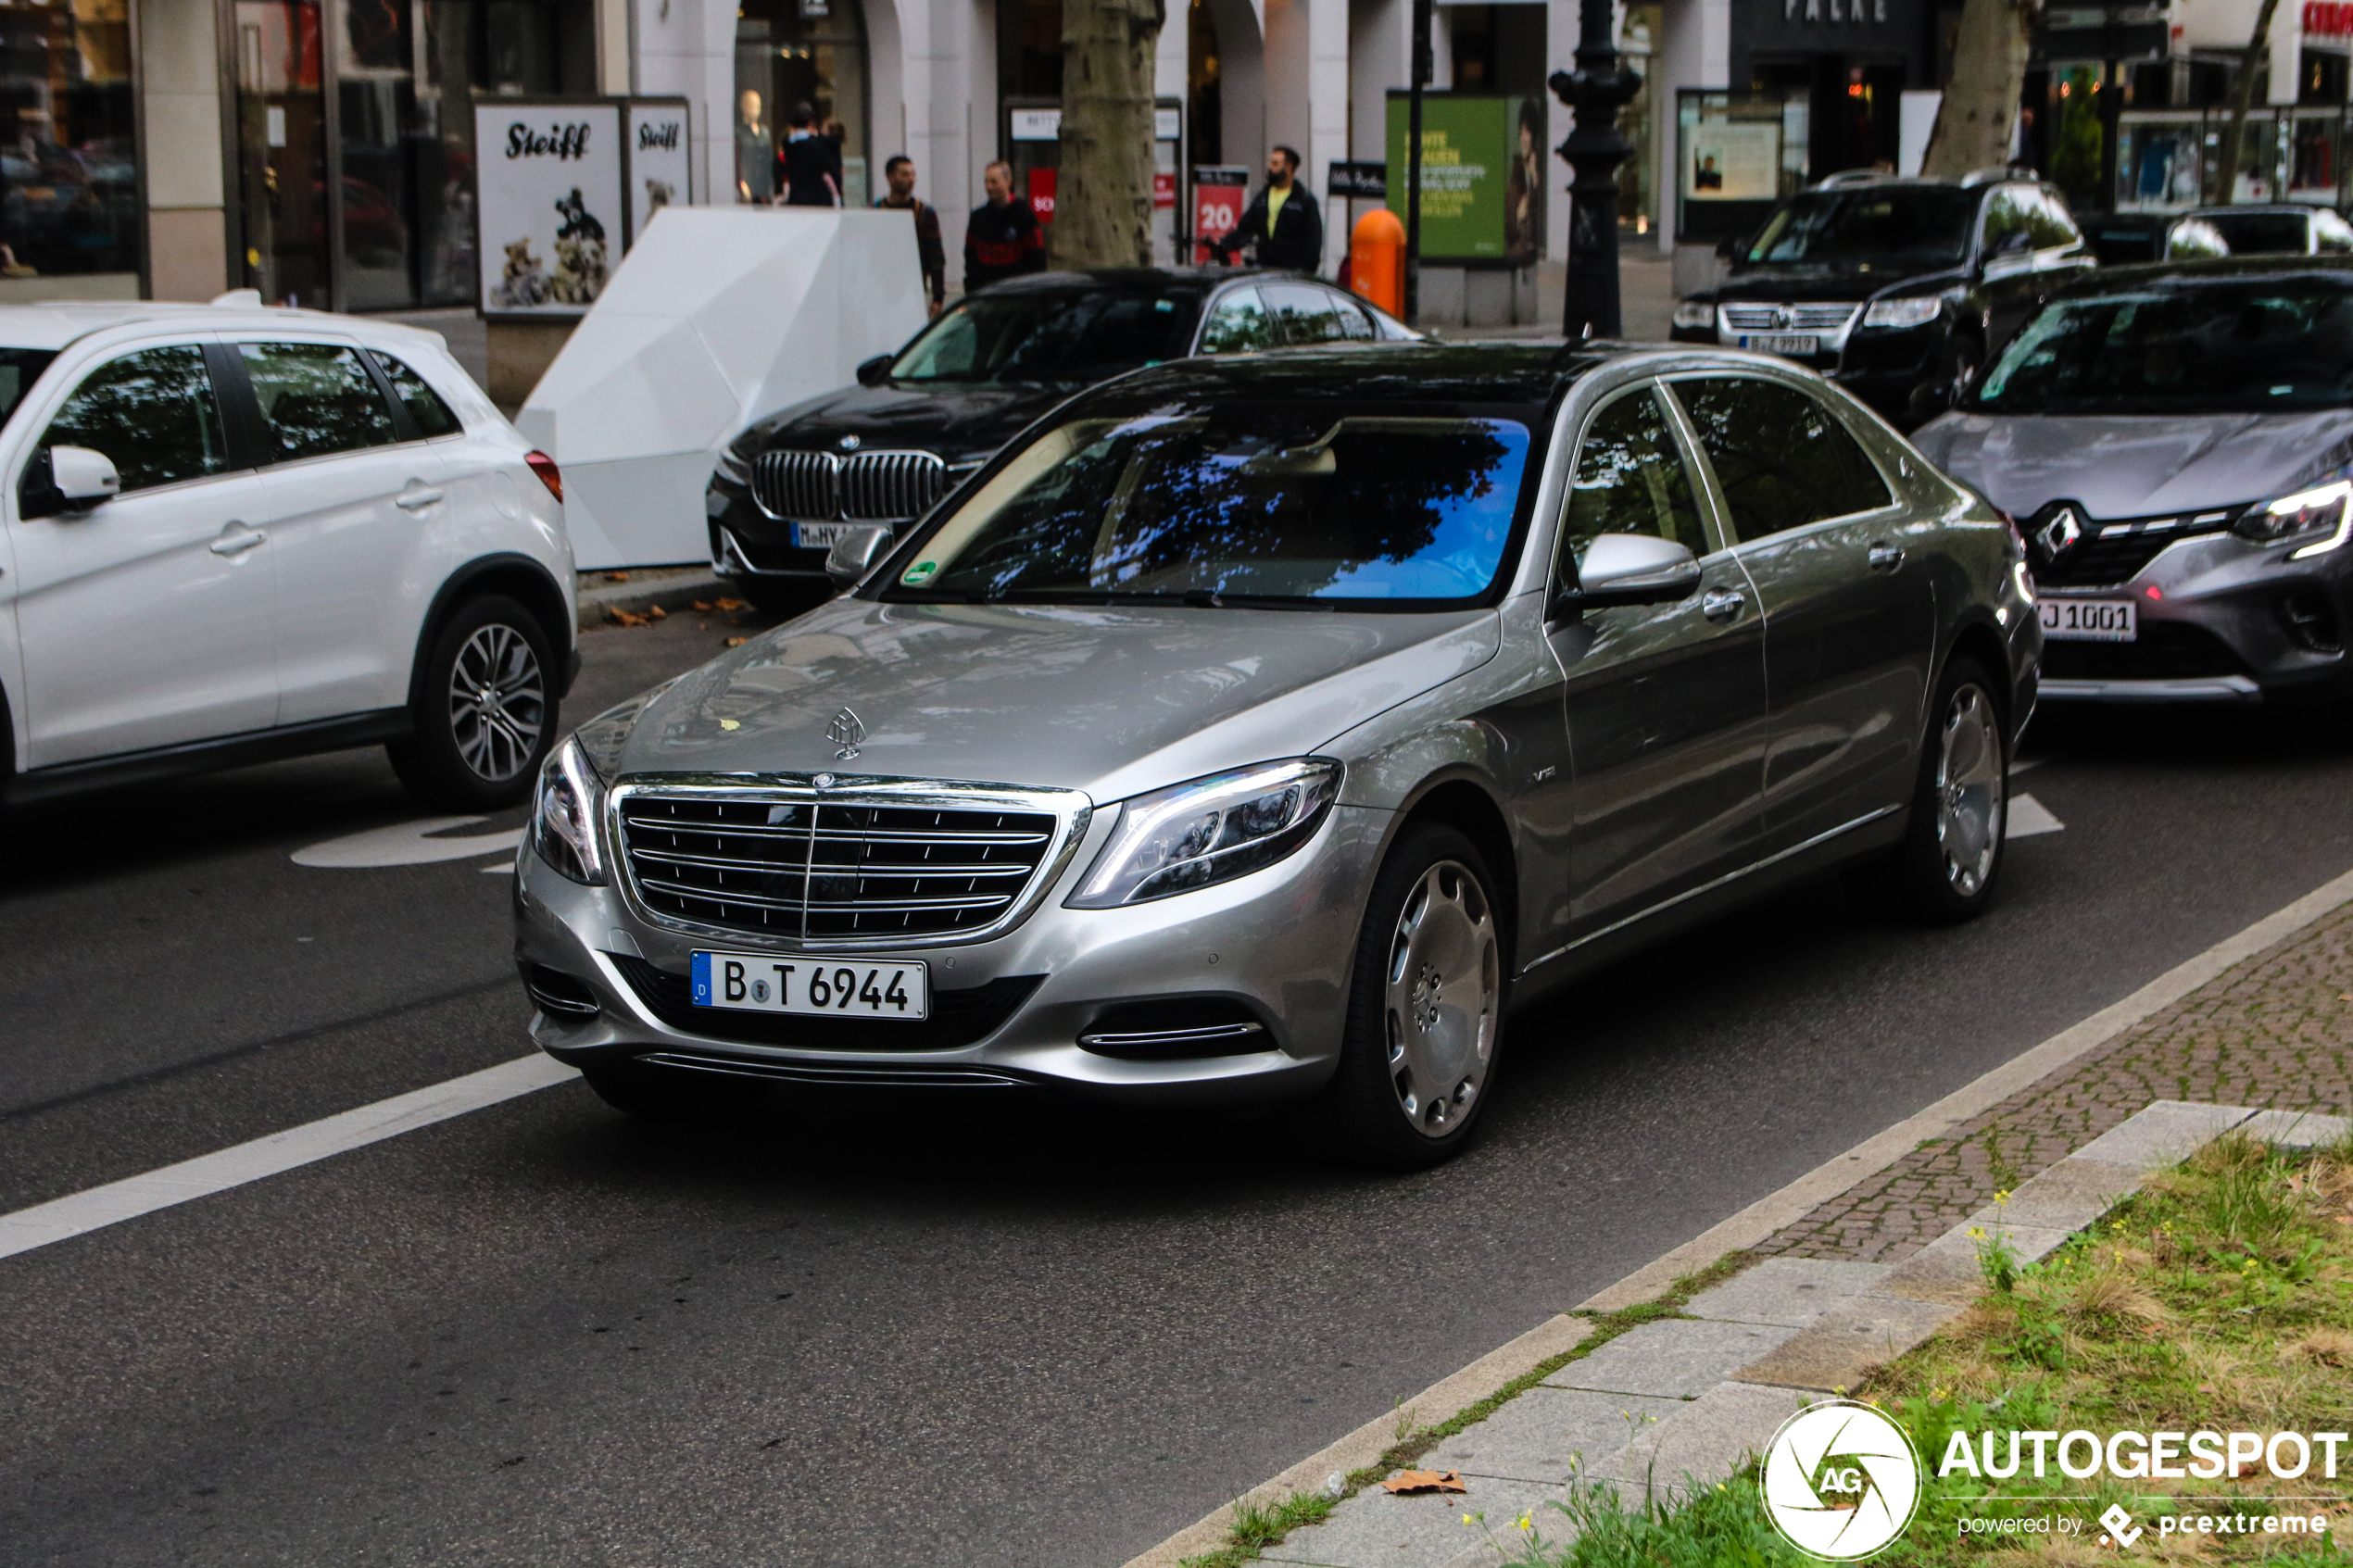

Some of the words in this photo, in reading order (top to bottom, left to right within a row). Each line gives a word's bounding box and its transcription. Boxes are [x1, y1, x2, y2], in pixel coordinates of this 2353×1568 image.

[506, 122, 590, 160] Steiff
[639, 122, 679, 150] Steiff
[2066, 604, 2130, 631] 1001
[1533, 765, 1556, 782] V12
[698, 985, 706, 996] D
[725, 960, 747, 1001] B
[773, 964, 795, 1005] T
[809, 967, 908, 1011] 6944
